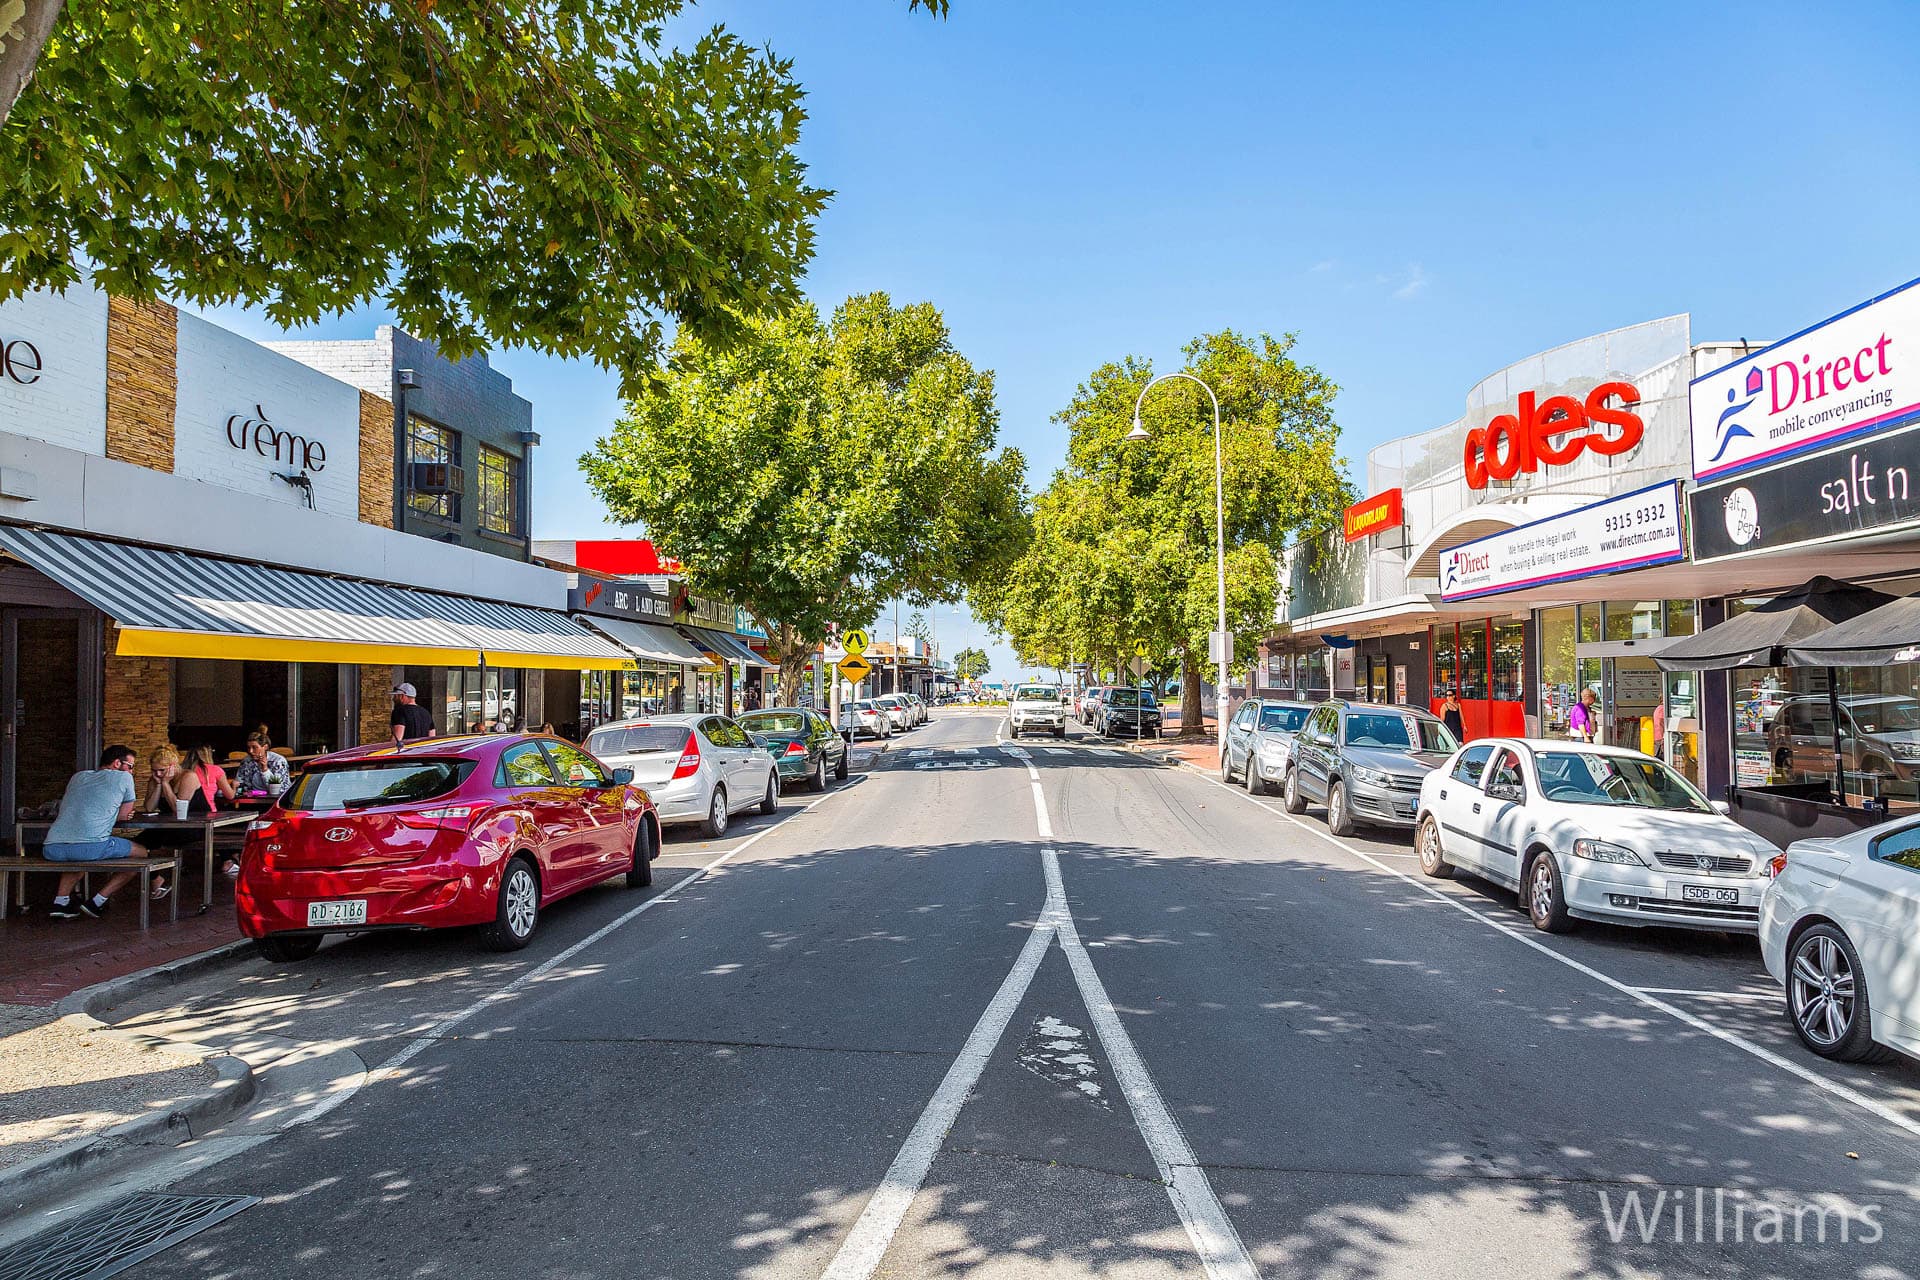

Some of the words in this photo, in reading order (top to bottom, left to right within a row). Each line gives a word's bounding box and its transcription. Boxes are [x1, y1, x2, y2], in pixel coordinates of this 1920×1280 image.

[1767, 332, 1892, 416] Direct
[1769, 415, 1805, 439] mobile
[1808, 389, 1893, 421] conveyancing
[227, 404, 326, 472] crème
[1464, 382, 1644, 490] coles
[1821, 454, 1876, 515] salt
[1886, 467, 1908, 500] n
[1723, 493, 1741, 512] salt
[1741, 507, 1747, 518] n
[1354, 504, 1389, 531] LIQUORLAND
[1605, 512, 1632, 533] 9315
[1636, 503, 1666, 525] 9332
[1737, 520, 1761, 540] pepa
[1508, 544, 1517, 555] We
[1517, 540, 1535, 553] handle
[1535, 537, 1545, 548] the
[1545, 532, 1561, 548] legal
[1561, 527, 1577, 542] work
[1600, 526, 1675, 552] www.directmc.com.au
[1460, 552, 1490, 575] Direct
[1500, 561, 1513, 573] when
[1513, 558, 1531, 572] buying
[1531, 555, 1536, 566] &
[1537, 551, 1556, 565] selling
[1556, 546, 1569, 561] real
[1569, 543, 1591, 558] estate.
[640, 597, 653, 614] AND
[654, 600, 671, 617] GRILL
[311, 903, 363, 919] RD-2186
